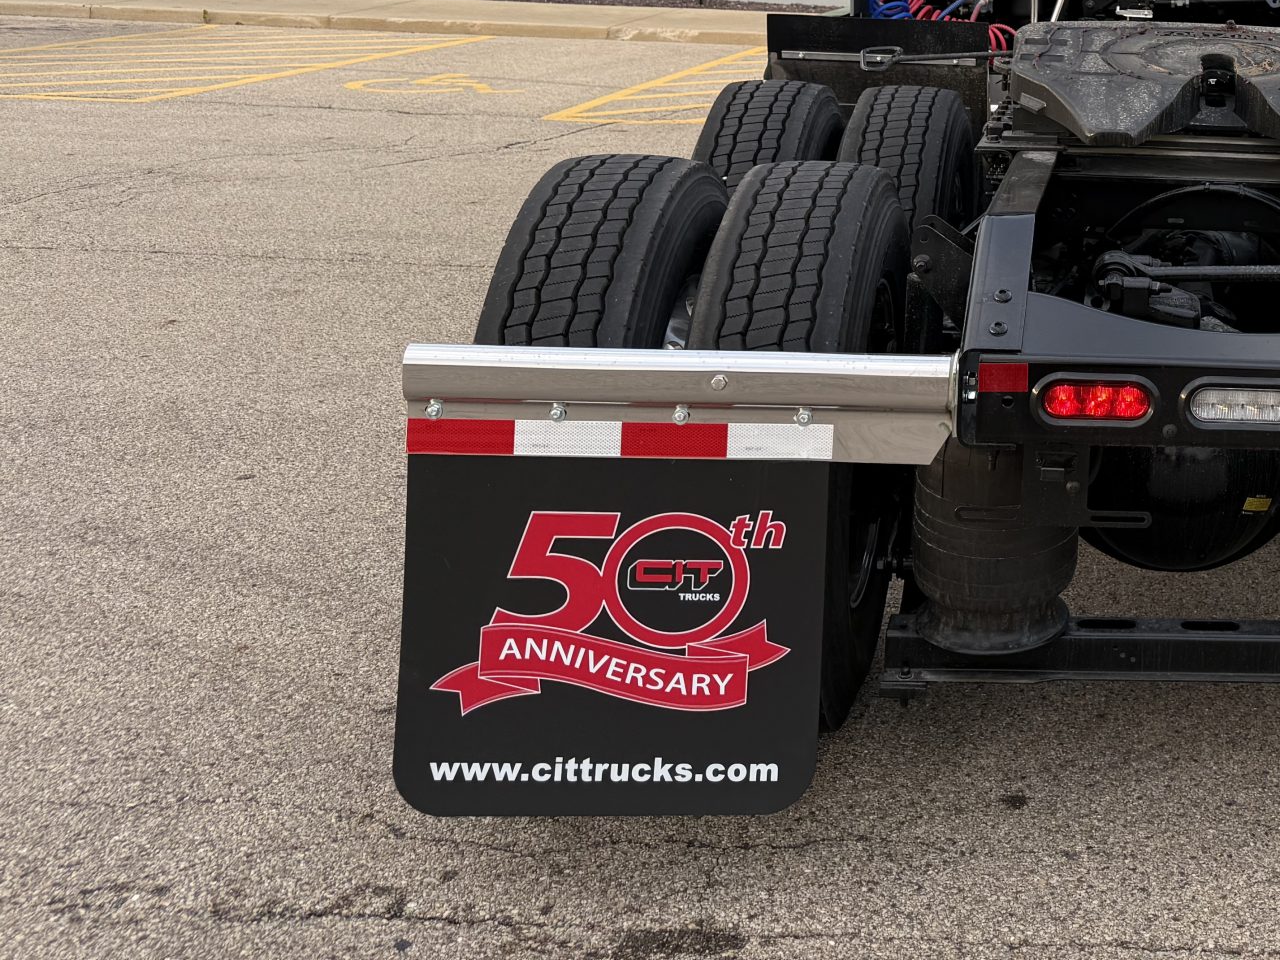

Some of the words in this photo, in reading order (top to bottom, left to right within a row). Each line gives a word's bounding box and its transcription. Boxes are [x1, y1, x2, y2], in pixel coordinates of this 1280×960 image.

[628, 559, 724, 591] CIT
[679, 592, 720, 601] TRUCKS
[499, 638, 734, 696] ANNIVERSARY
[430, 758, 779, 782] www.cittrucks.com
